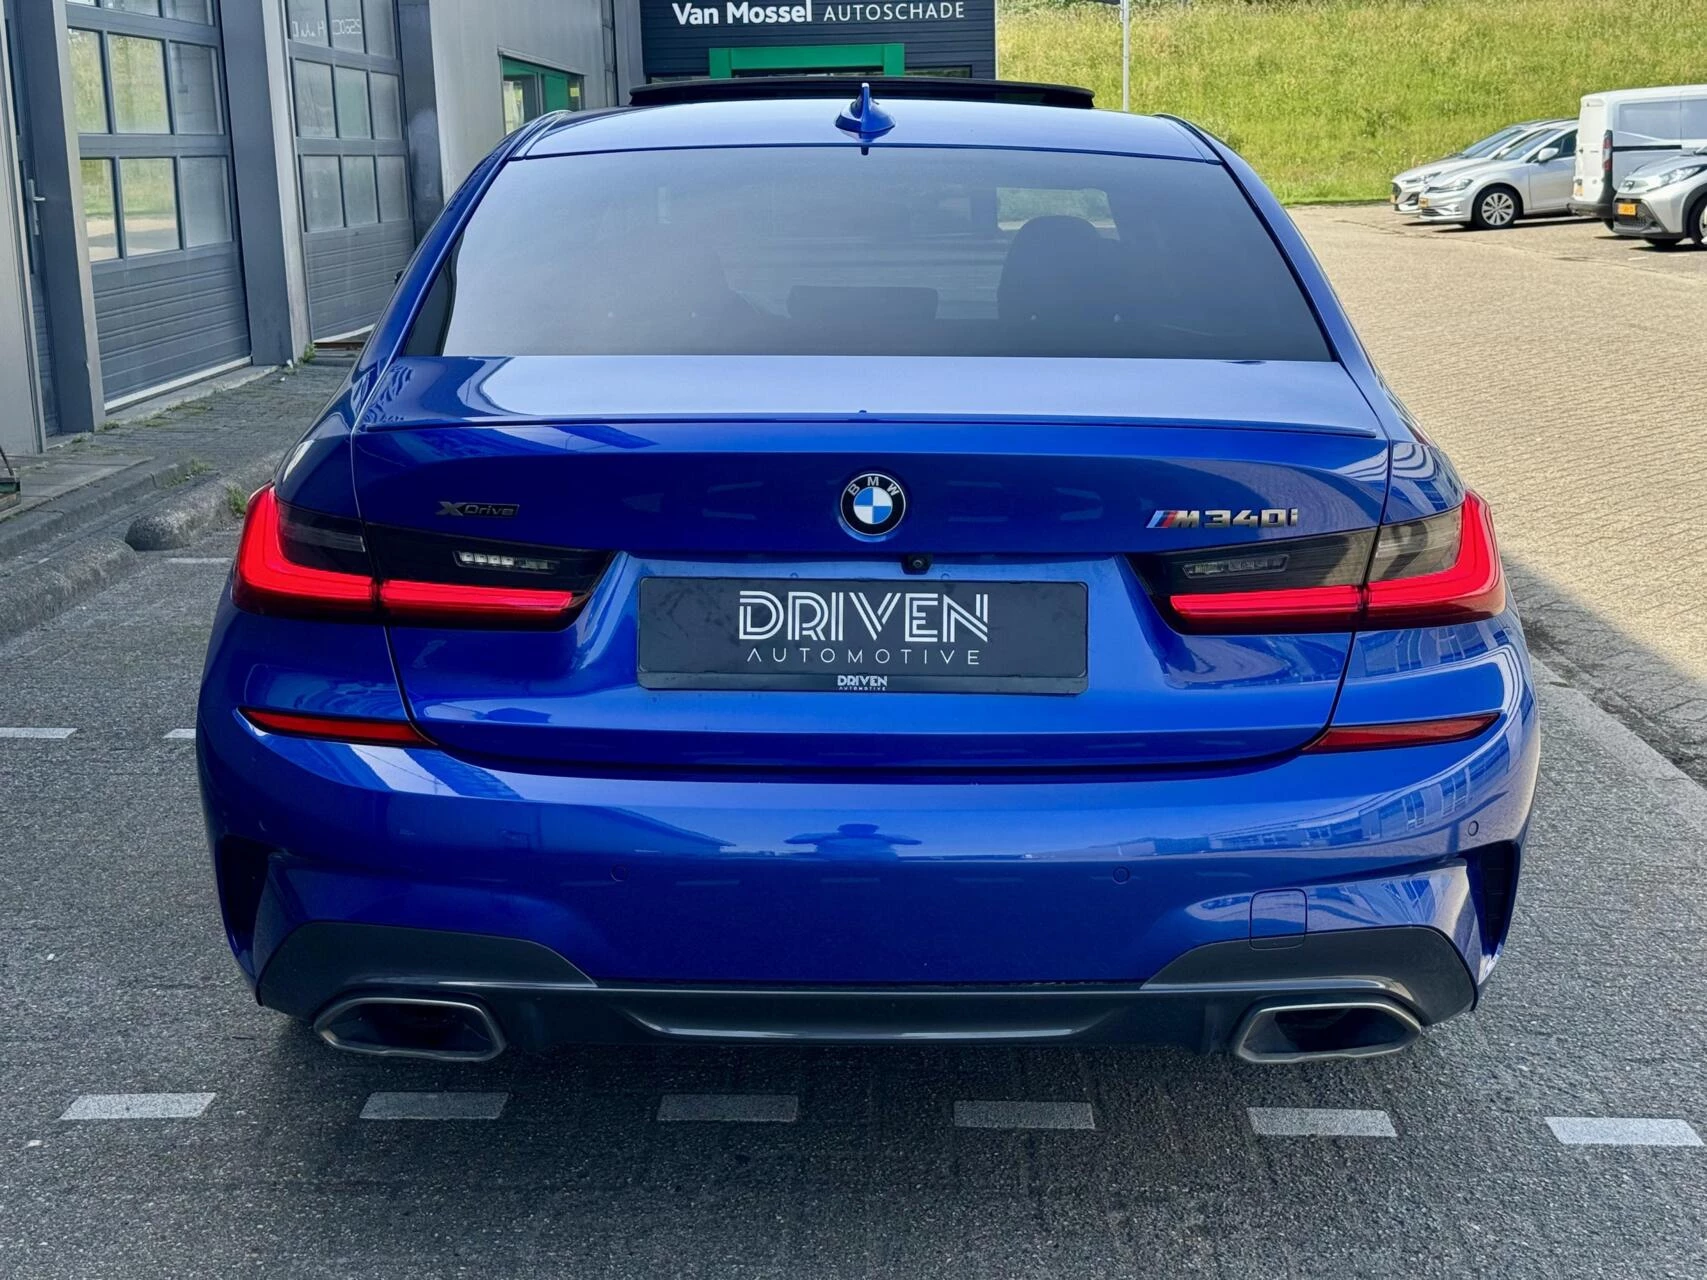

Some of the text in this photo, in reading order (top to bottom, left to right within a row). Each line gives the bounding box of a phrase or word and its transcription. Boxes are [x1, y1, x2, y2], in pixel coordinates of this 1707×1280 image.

[672, 0, 966, 25] Van Mossel AUTOSCHADE
[847, 476, 900, 496] BMW
[1171, 508, 1299, 529] M340i
[738, 590, 989, 643] DRIVEN
[746, 648, 981, 665] AUTOMOTIVE
[837, 675, 888, 686] DRIVEN
